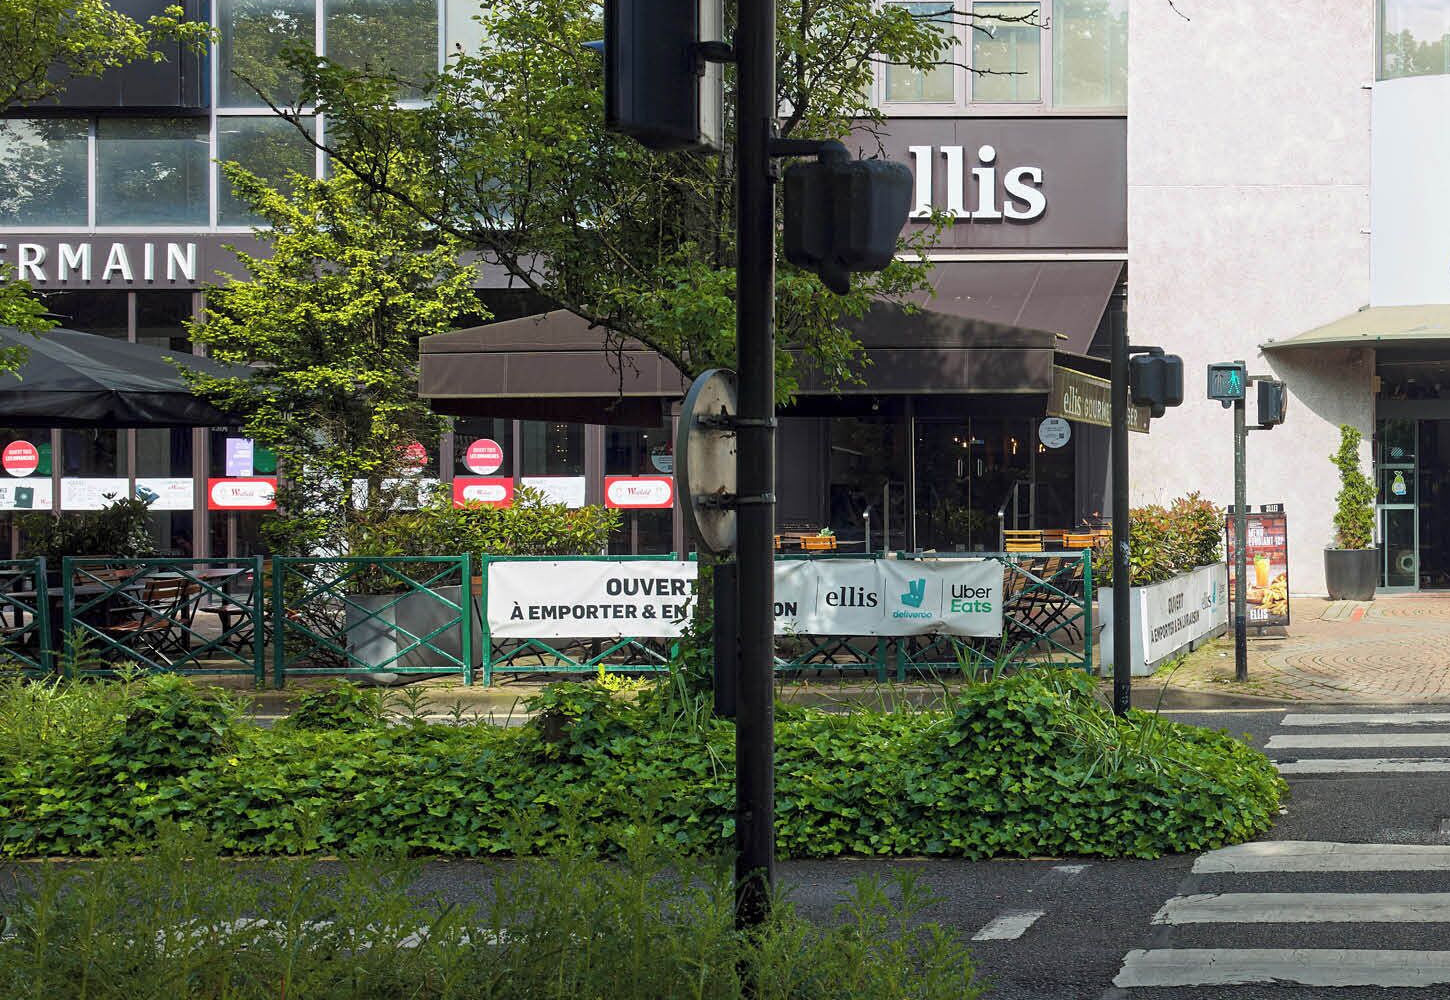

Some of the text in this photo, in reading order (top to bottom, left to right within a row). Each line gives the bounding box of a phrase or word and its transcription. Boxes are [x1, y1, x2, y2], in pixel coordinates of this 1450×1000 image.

[907, 144, 1047, 222] llis
[1063, 386, 1081, 416] ellis
[825, 587, 878, 608] ellis
[951, 584, 993, 599] Uber
[510, 601, 687, 620] À EMPORTER & EN
[893, 609, 933, 619] deliveroo
[950, 599, 993, 613] Eats
